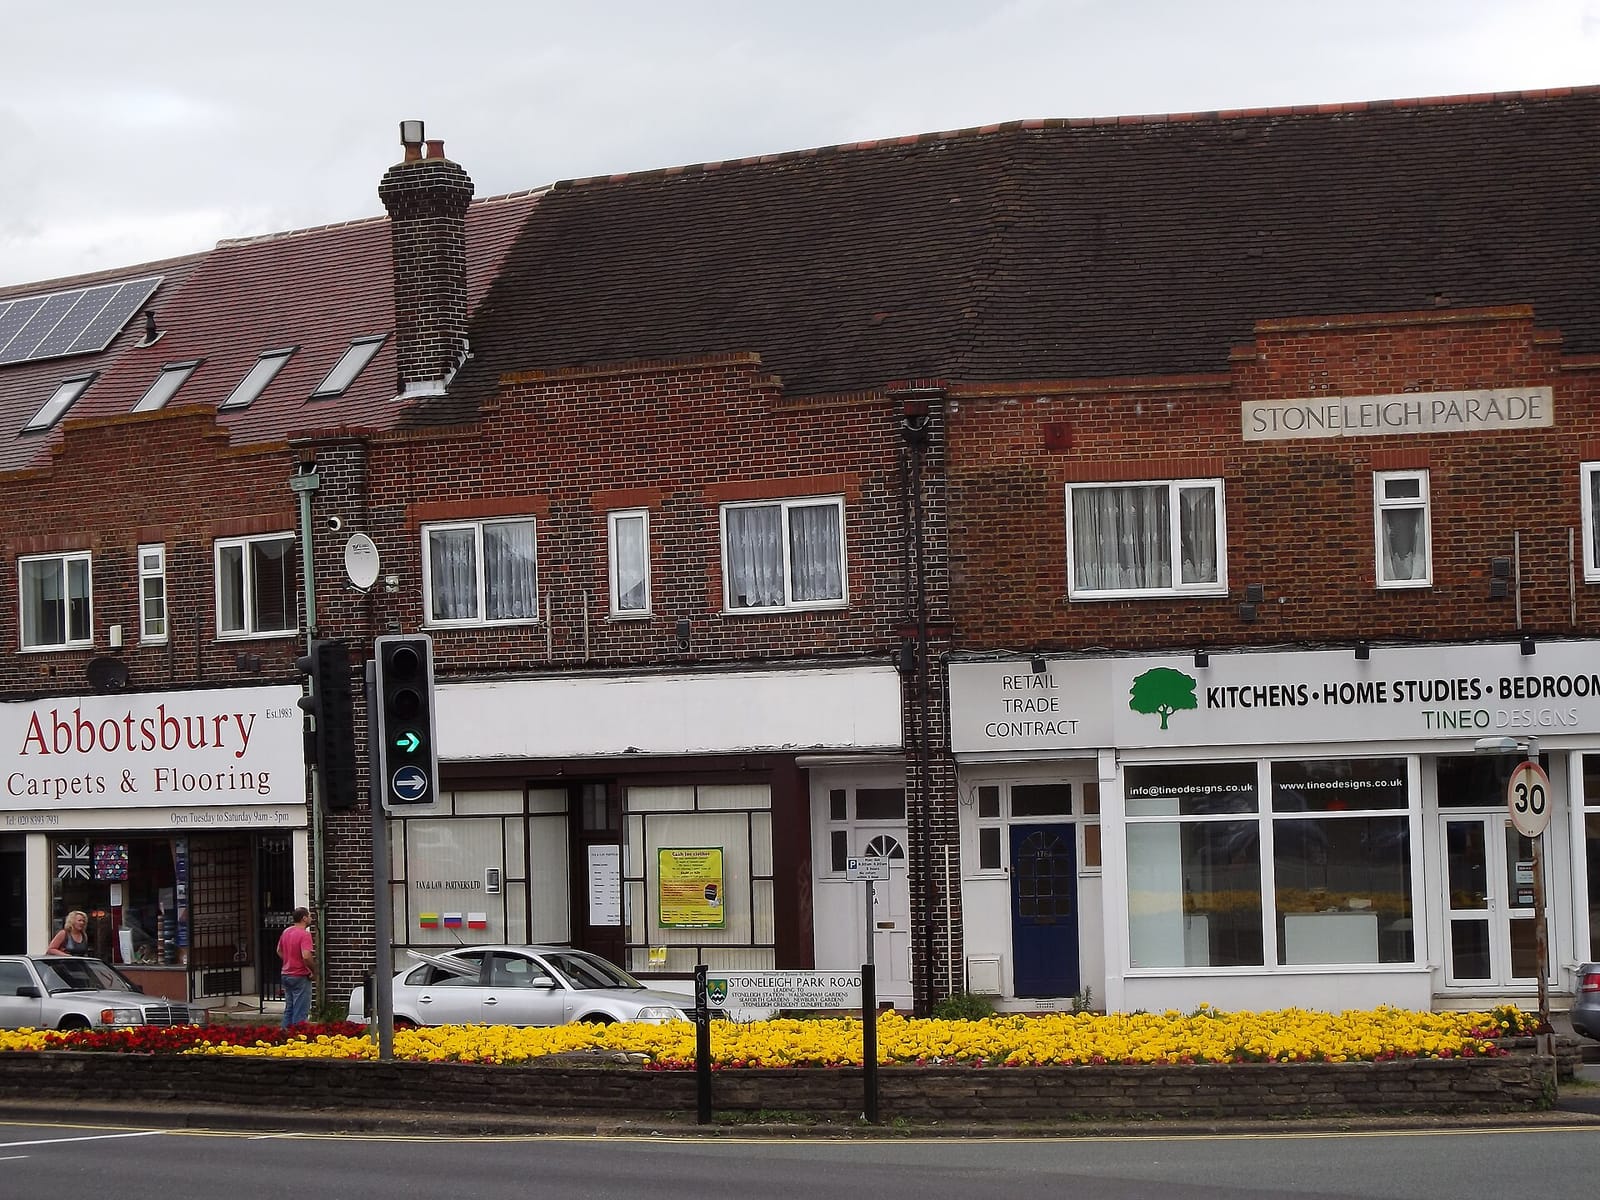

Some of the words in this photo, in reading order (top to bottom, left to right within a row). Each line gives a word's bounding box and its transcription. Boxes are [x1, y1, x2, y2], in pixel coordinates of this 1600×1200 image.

[1252, 401, 1422, 433] STONELEIGH
[1431, 394, 1542, 425] PARADE
[1002, 674, 1060, 691] RETAIL
[1206, 683, 1308, 709] KITCHENS
[1323, 681, 1388, 705] HOME
[1393, 677, 1482, 702] STUDIES
[1002, 697, 1060, 714] TRADE
[1421, 709, 1490, 730] TINEO
[1496, 707, 1579, 728] DESIGNS
[19, 704, 257, 758] Abbotsbury
[985, 720, 1079, 738] CONTRACT
[7, 772, 106, 800] Carpets
[120, 768, 138, 793] &
[153, 765, 271, 795] Flooring
[1129, 783, 1253, 797] info@tineodesigns.co.uk
[1279, 778, 1403, 791] www.tineodesigns.co.uk
[1514, 783, 1546, 815] 30
[170, 813, 188, 824] Open
[189, 812, 215, 824] Tuesday
[216, 812, 223, 821] to
[224, 811, 252, 824] Saturday
[253, 811, 268, 821] 9am
[274, 810, 289, 823] 5pm
[729, 977, 792, 988] STONELEIGH
[796, 977, 825, 988] PARK
[830, 977, 862, 988] ROAD
